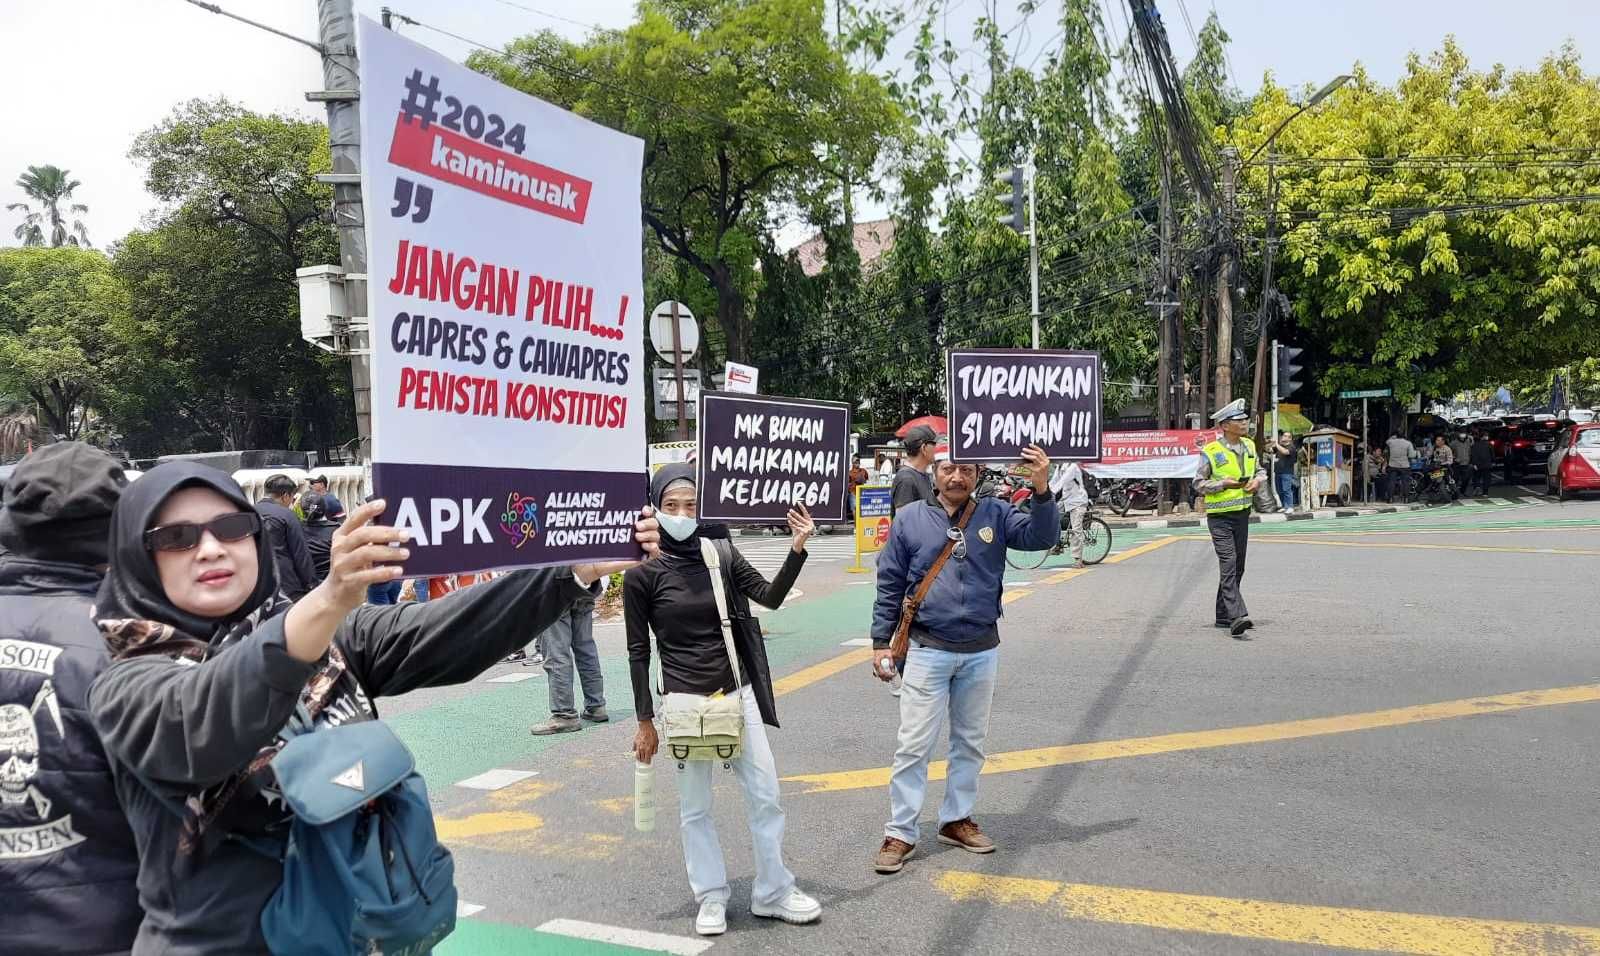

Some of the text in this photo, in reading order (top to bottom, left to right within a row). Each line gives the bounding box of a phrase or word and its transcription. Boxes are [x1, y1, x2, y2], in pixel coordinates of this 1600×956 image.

[398, 68, 526, 155] #2024
[430, 134, 578, 213] kamimuak
[389, 240, 519, 316] JANGAN
[391, 312, 630, 386] CAPRES & CAWAPRES
[398, 367, 628, 429] PENISTA KONSTITUSI
[957, 364, 1092, 401] TURUNKAN
[733, 413, 824, 445] MK BUKAN
[961, 410, 1092, 449] SI PAMAN !!!
[710, 445, 840, 479] MAHKAMAH
[1117, 445, 1188, 457] PAHLAWAN
[545, 492, 606, 509] ALIANSI
[719, 477, 830, 507] KELUARGA
[395, 497, 494, 546] APK
[545, 510, 641, 528] PENYELAMAT
[545, 528, 632, 547] KONSTITUSI
[0, 644, 51, 670] SOH
[0, 821, 73, 853] NSEN
